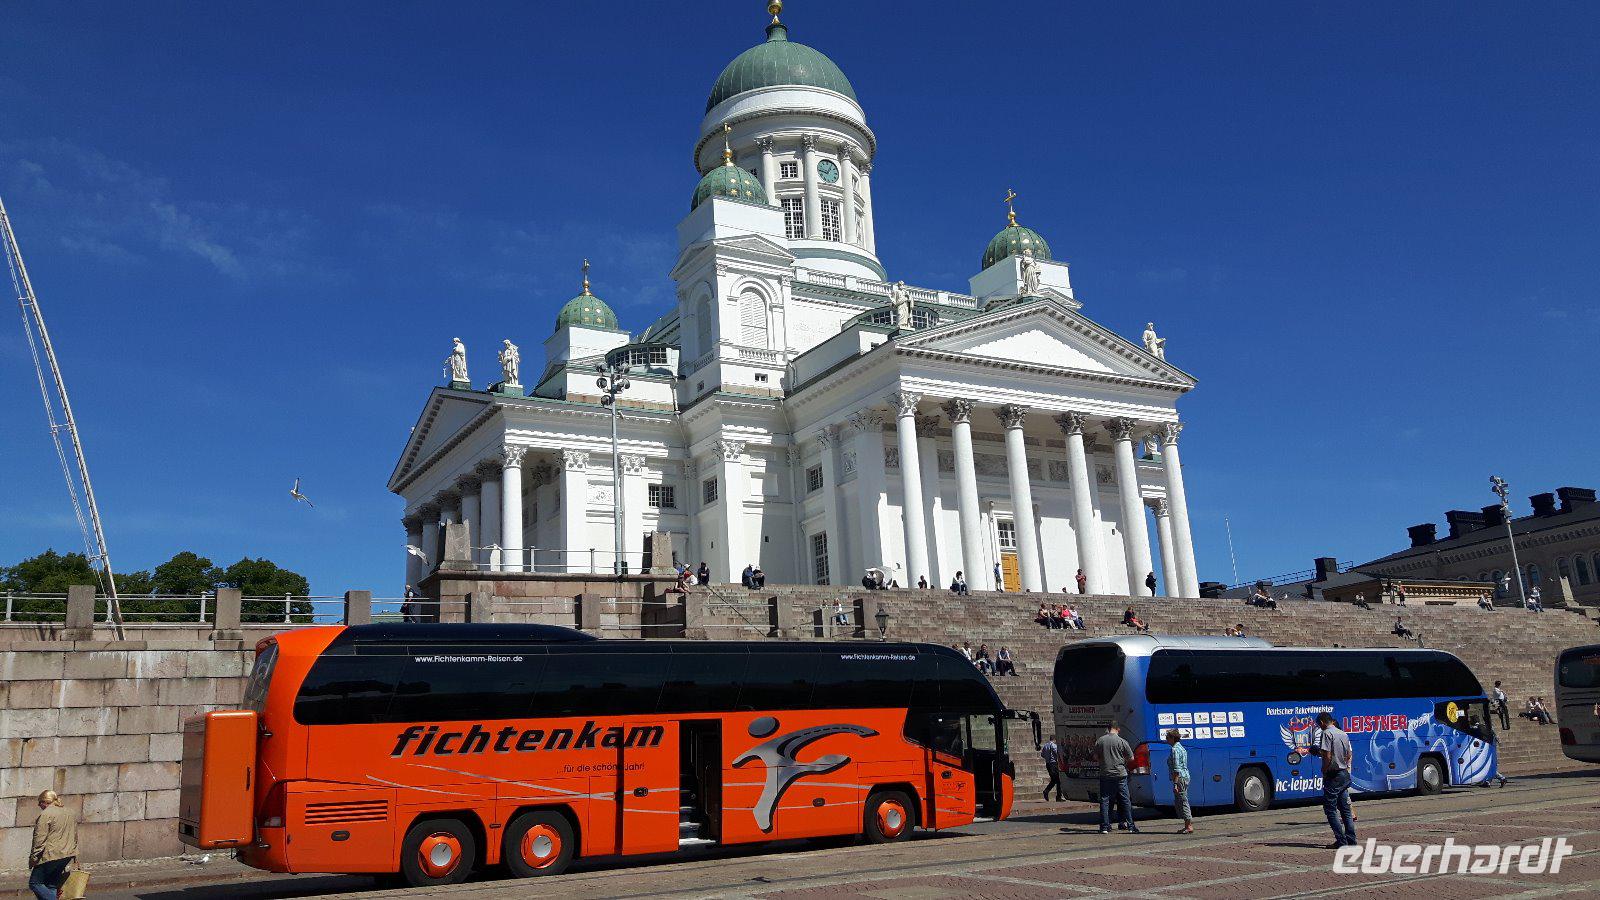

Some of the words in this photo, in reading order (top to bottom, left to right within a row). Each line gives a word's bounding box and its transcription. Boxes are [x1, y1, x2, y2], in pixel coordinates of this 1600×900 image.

[1266, 707, 1294, 716] Deutscher
[1295, 705, 1334, 715] Rekordmeister
[1342, 714, 1408, 734] LEISTNER
[577, 764, 591, 772] die
[624, 762, 645, 771] Jahr!
[1275, 775, 1325, 793] hc-leipzig.
